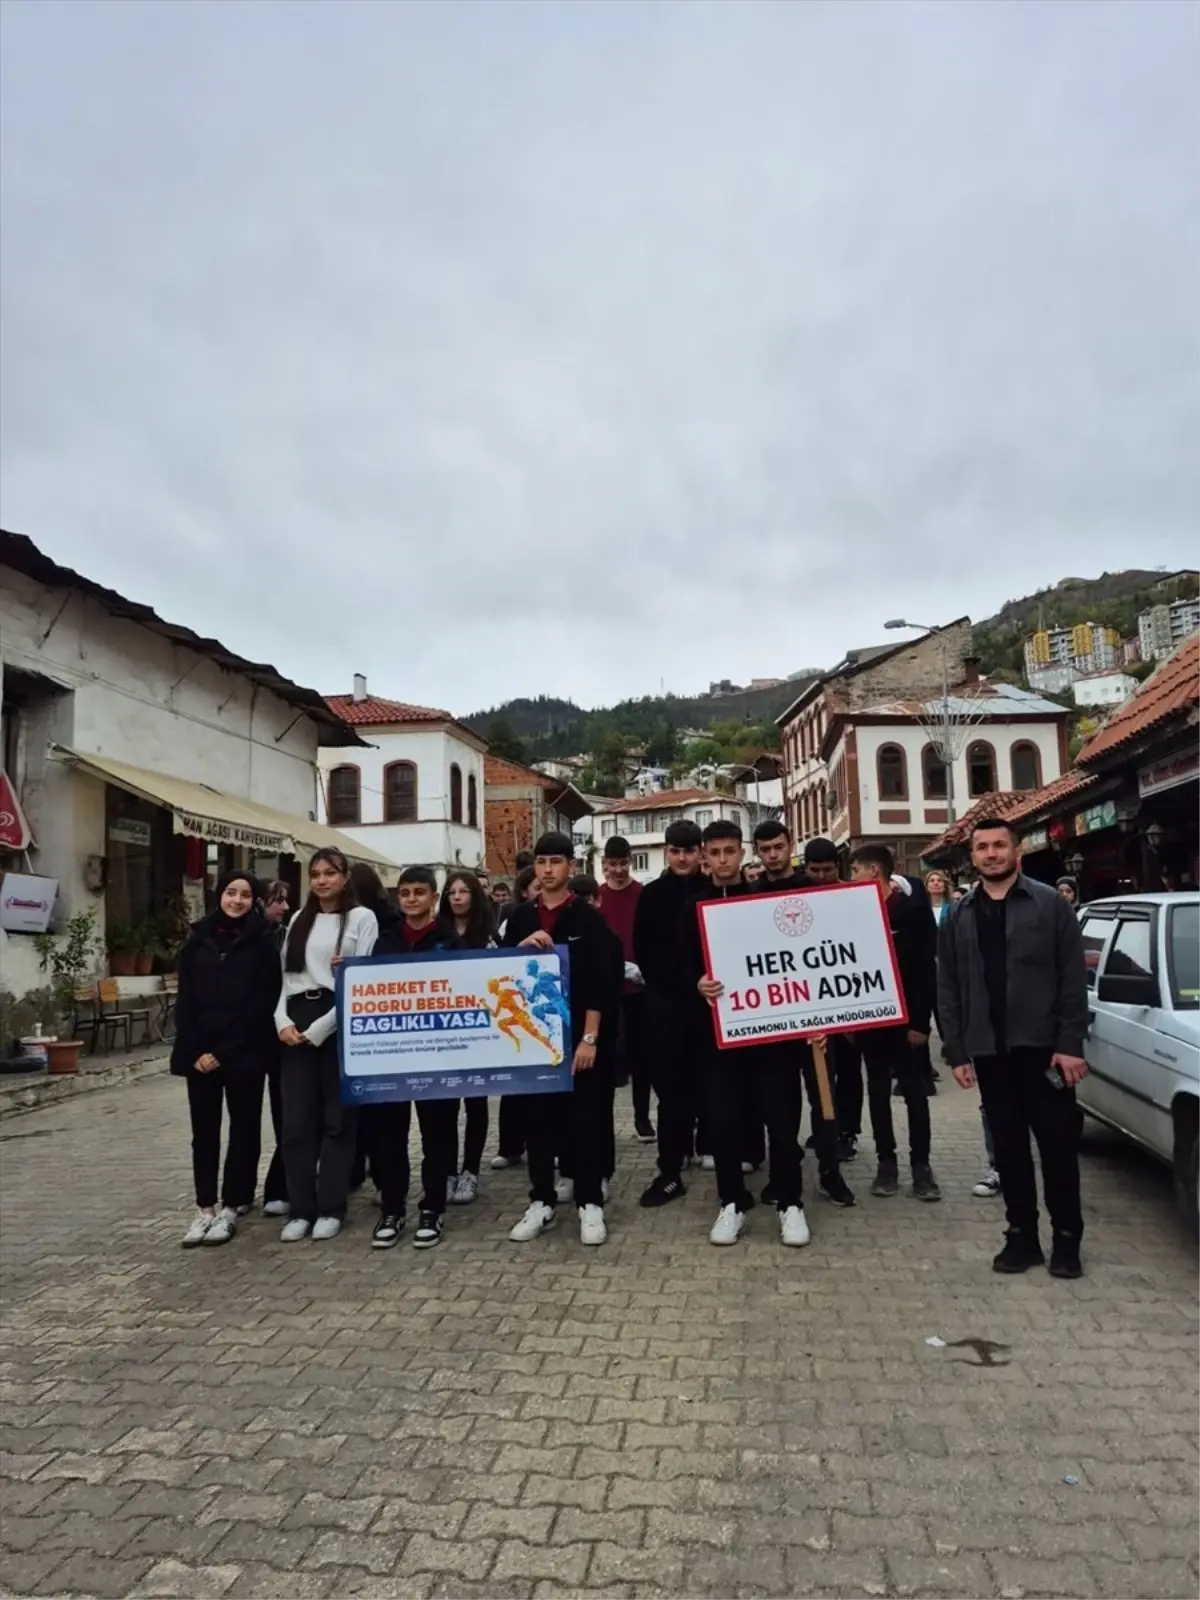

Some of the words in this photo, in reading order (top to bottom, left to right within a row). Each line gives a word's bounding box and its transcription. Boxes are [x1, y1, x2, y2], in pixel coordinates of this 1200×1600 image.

[746, 950, 796, 978] HER
[802, 939, 857, 969] GÜN
[352, 980, 427, 997] HAREKET
[429, 979, 453, 994] ET,
[729, 988, 761, 1012] 10
[768, 977, 811, 1007] BİN
[727, 1022, 788, 1038] KASTAMONU
[789, 1018, 799, 1030] İL
[801, 1014, 835, 1029] SAĞLIK
[837, 1005, 898, 1024] MÜDÜRLÜĞÜ
